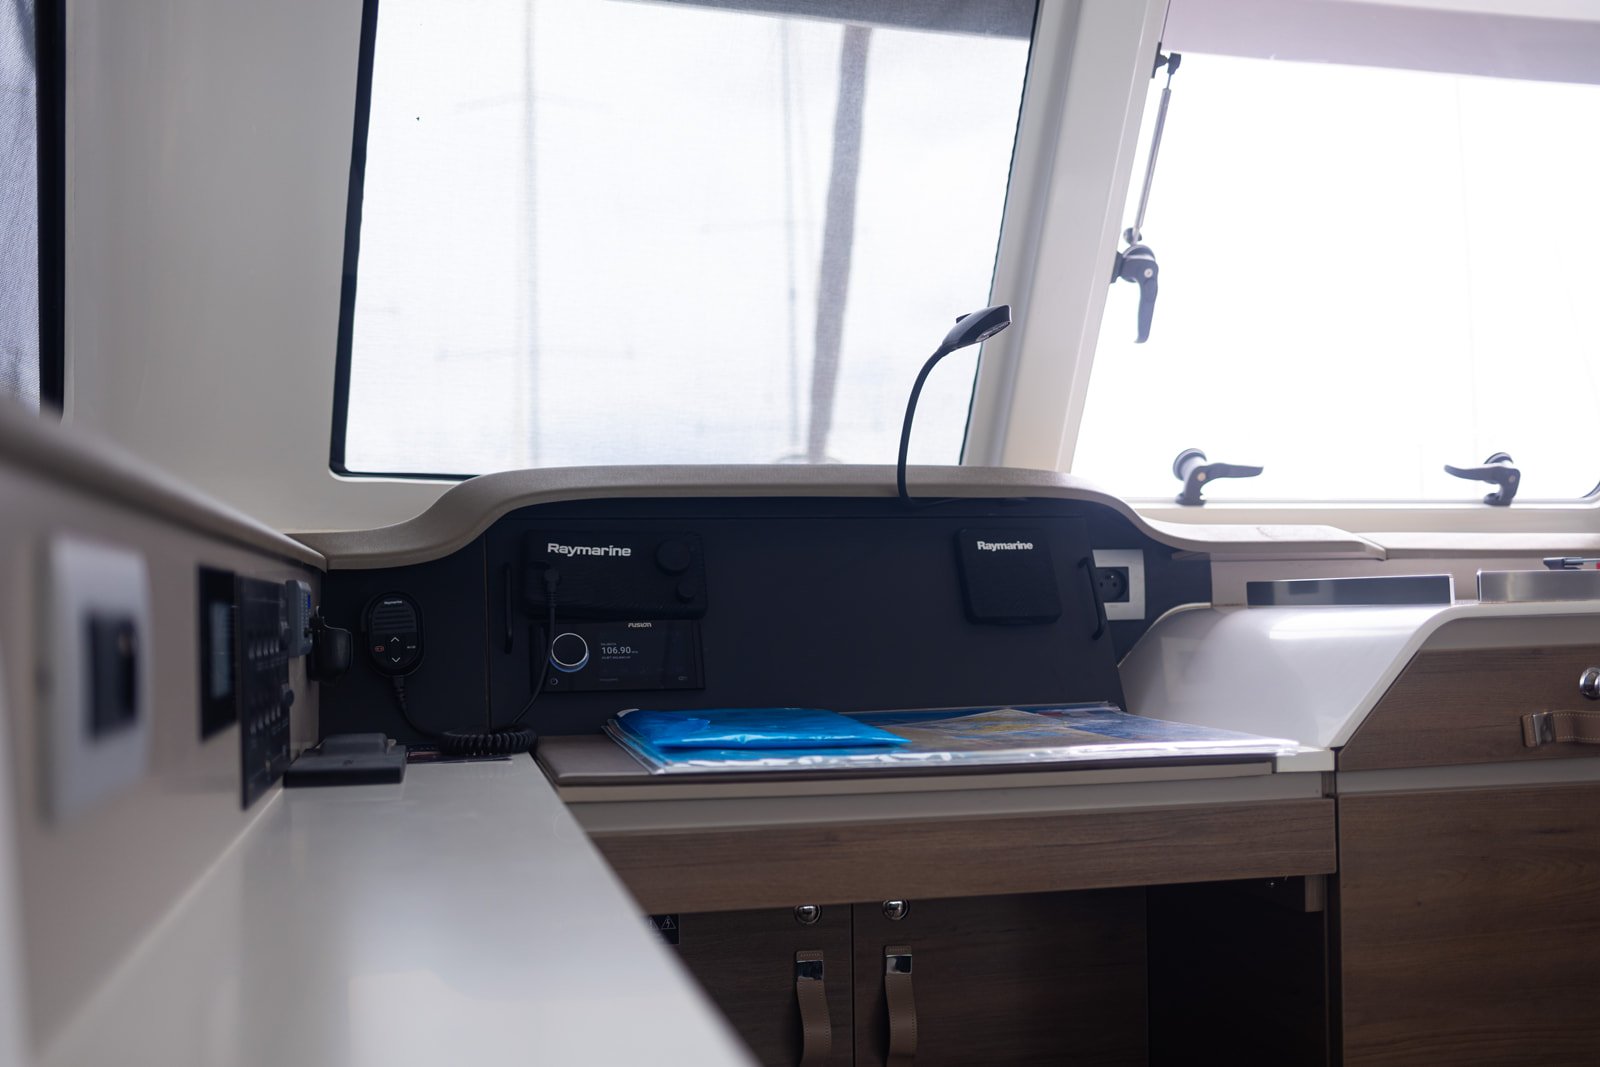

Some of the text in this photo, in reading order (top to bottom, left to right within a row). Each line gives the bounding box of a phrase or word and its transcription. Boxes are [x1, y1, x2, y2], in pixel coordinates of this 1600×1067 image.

[547, 542, 632, 557] Raymarine
[976, 540, 1034, 552] Raymarine
[601, 646, 631, 655] 106.90
